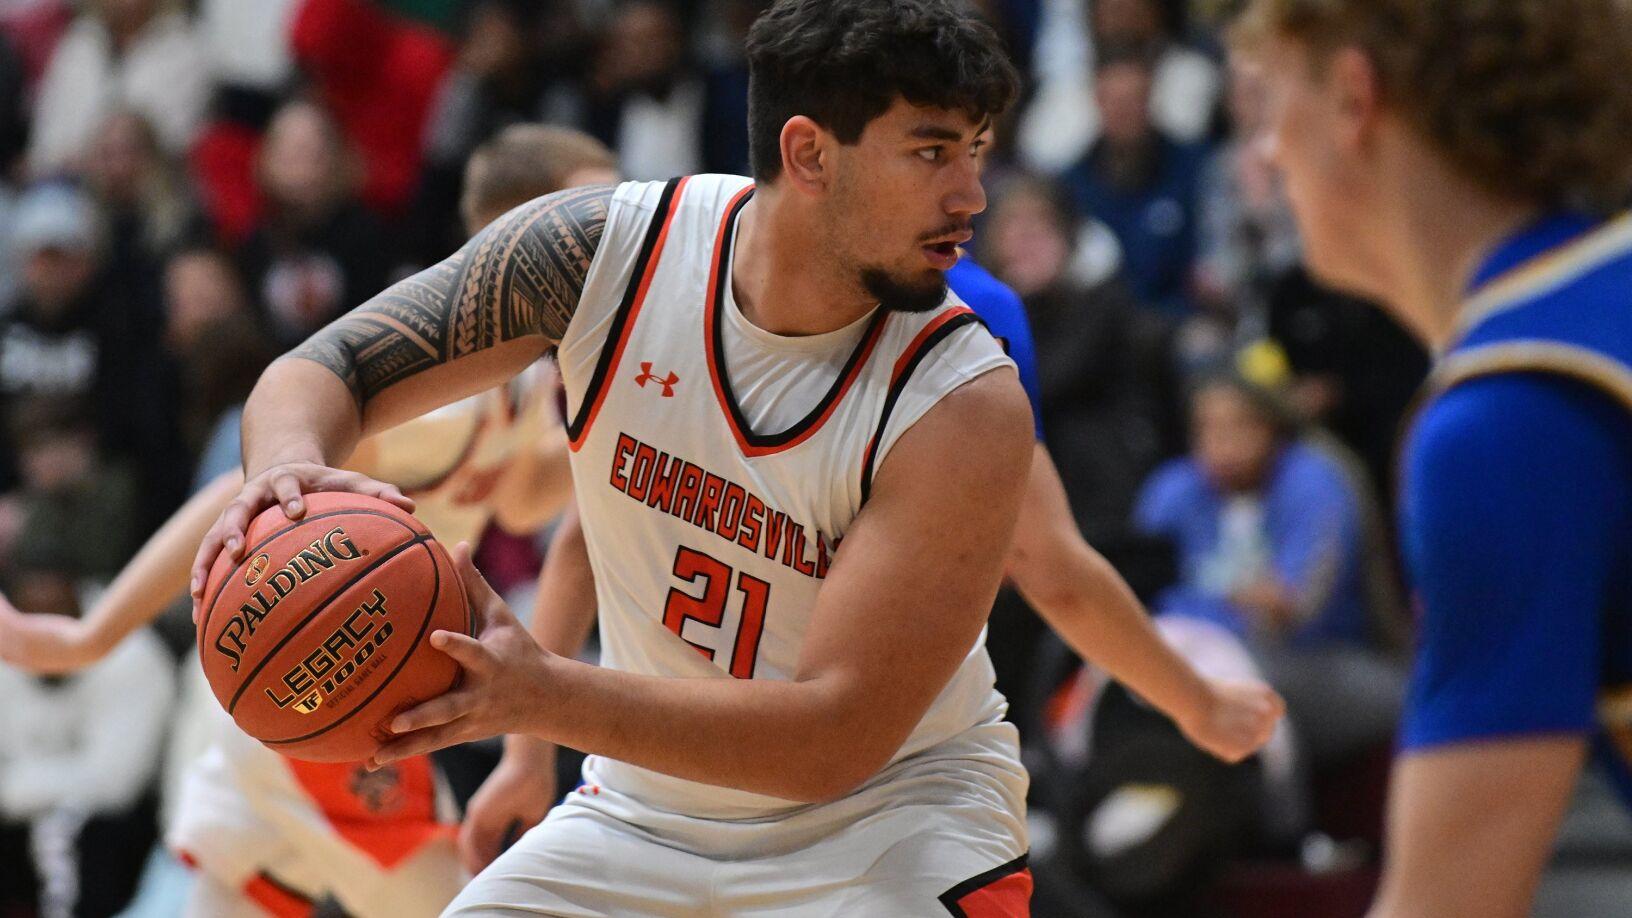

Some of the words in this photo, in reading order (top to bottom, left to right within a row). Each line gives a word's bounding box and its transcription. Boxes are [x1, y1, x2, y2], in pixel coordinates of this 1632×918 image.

[610, 432, 845, 579] EDWARDSVILL
[214, 526, 362, 673] SPALDING
[264, 587, 388, 710] LEGACY
[320, 621, 395, 696] 1000
[661, 544, 771, 680] 21
